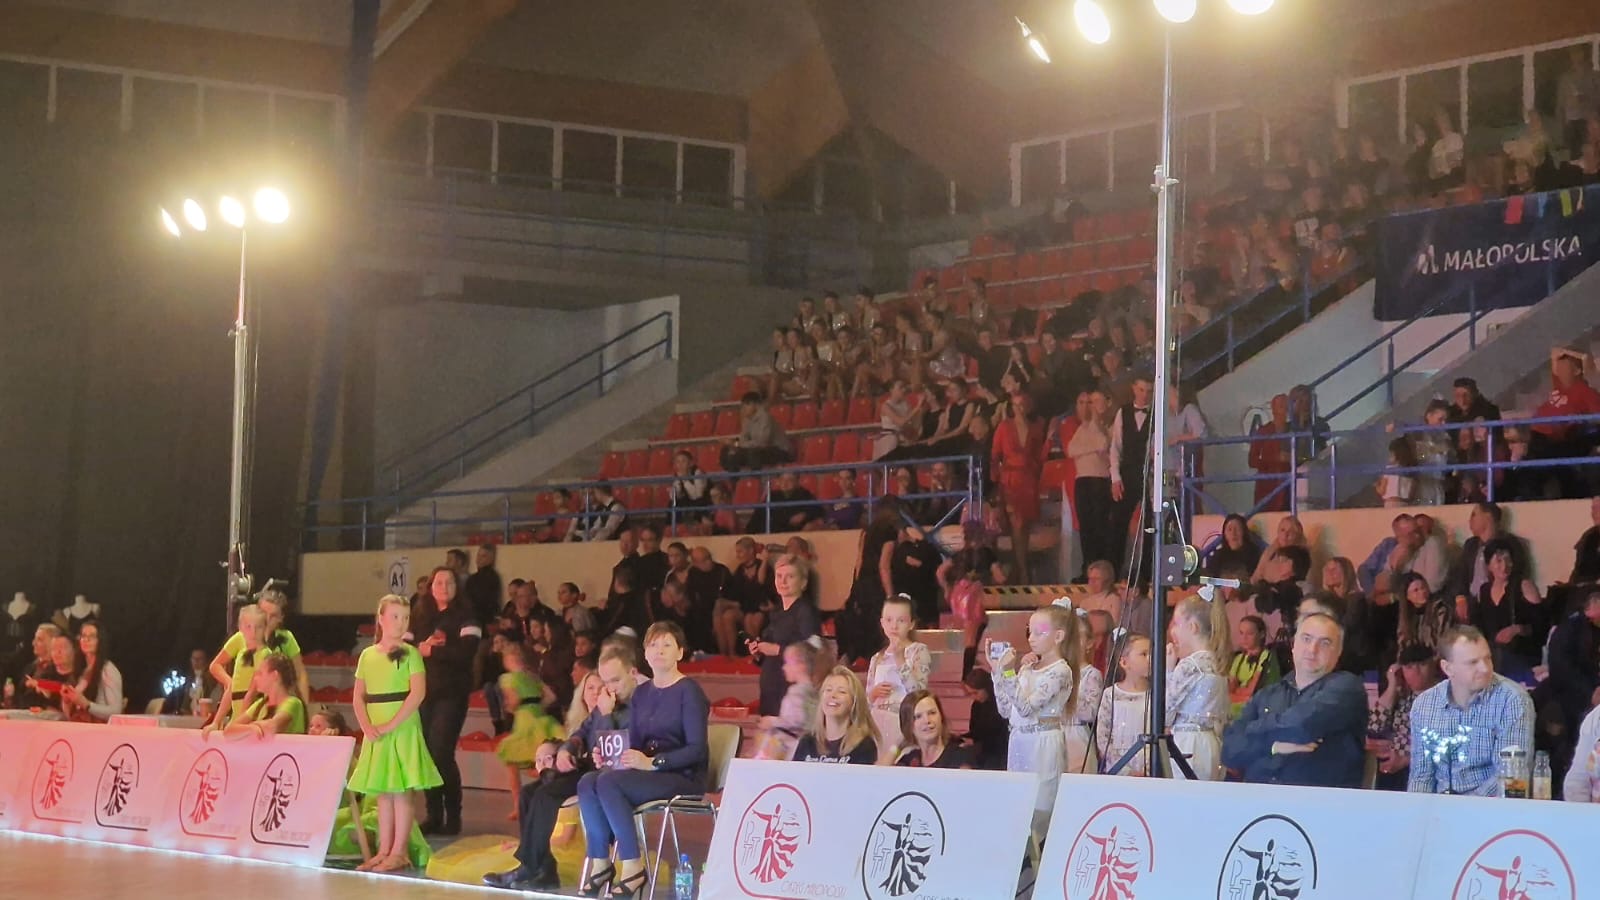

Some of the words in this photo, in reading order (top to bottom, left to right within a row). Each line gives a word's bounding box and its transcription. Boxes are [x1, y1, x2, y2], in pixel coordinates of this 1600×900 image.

[1443, 235, 1582, 272] MAŁOPOLSKA
[391, 572, 404, 587] A1
[598, 734, 624, 757] 169
